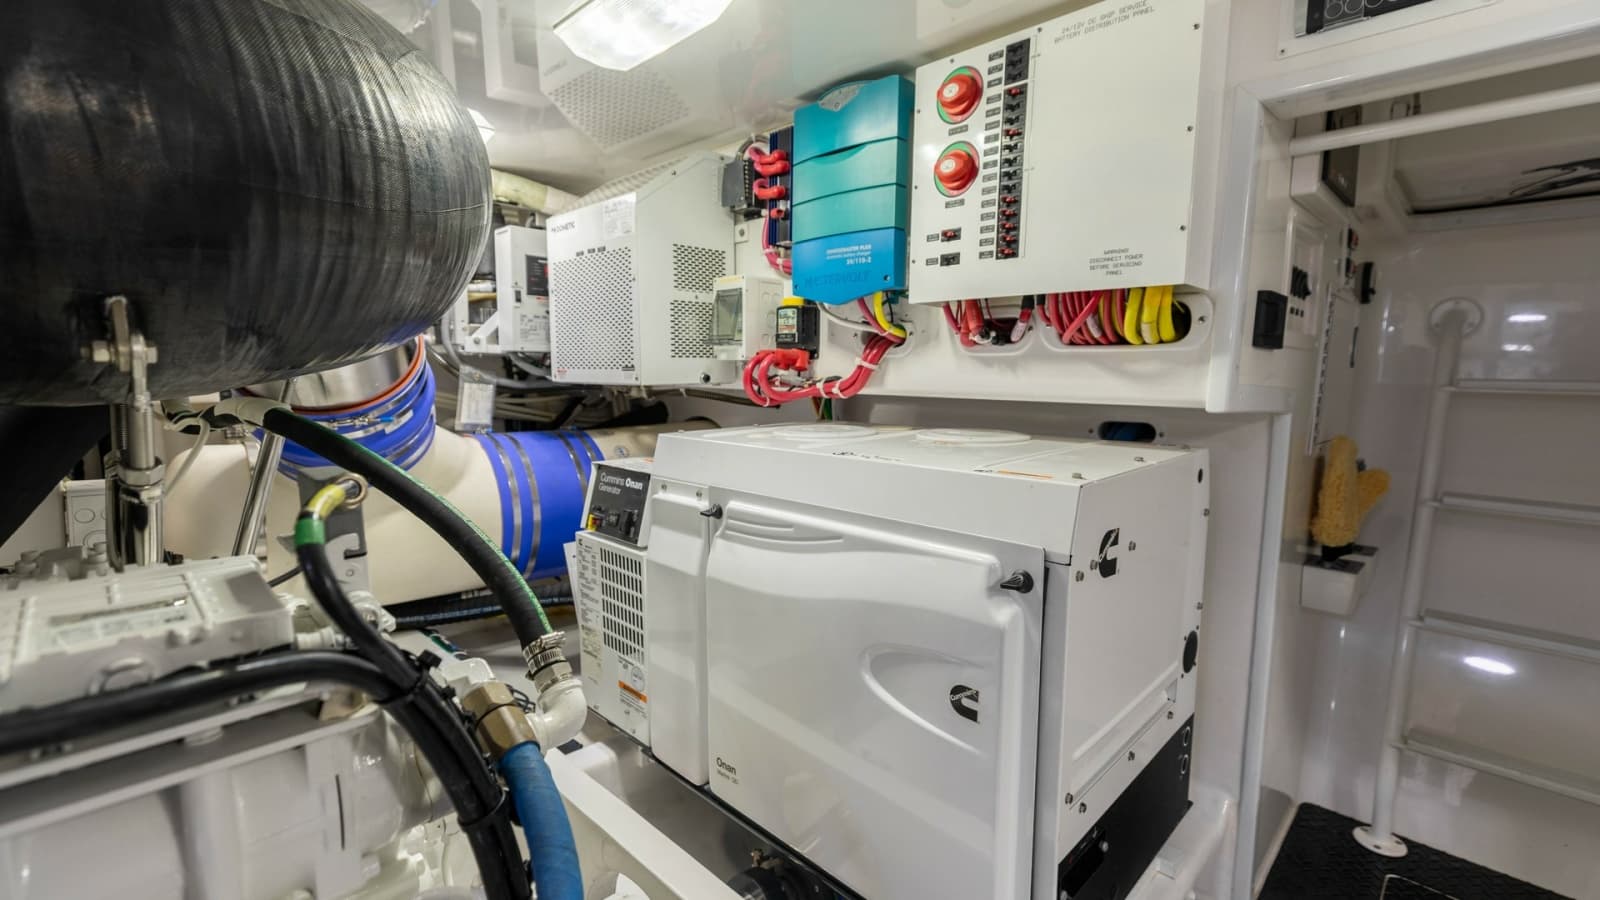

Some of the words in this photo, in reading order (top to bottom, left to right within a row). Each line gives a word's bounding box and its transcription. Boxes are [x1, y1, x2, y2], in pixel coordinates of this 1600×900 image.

[598, 482, 621, 495] Generator
[600, 472, 625, 486] Cummins
[625, 477, 643, 490] Onan
[716, 756, 737, 776] Onan
